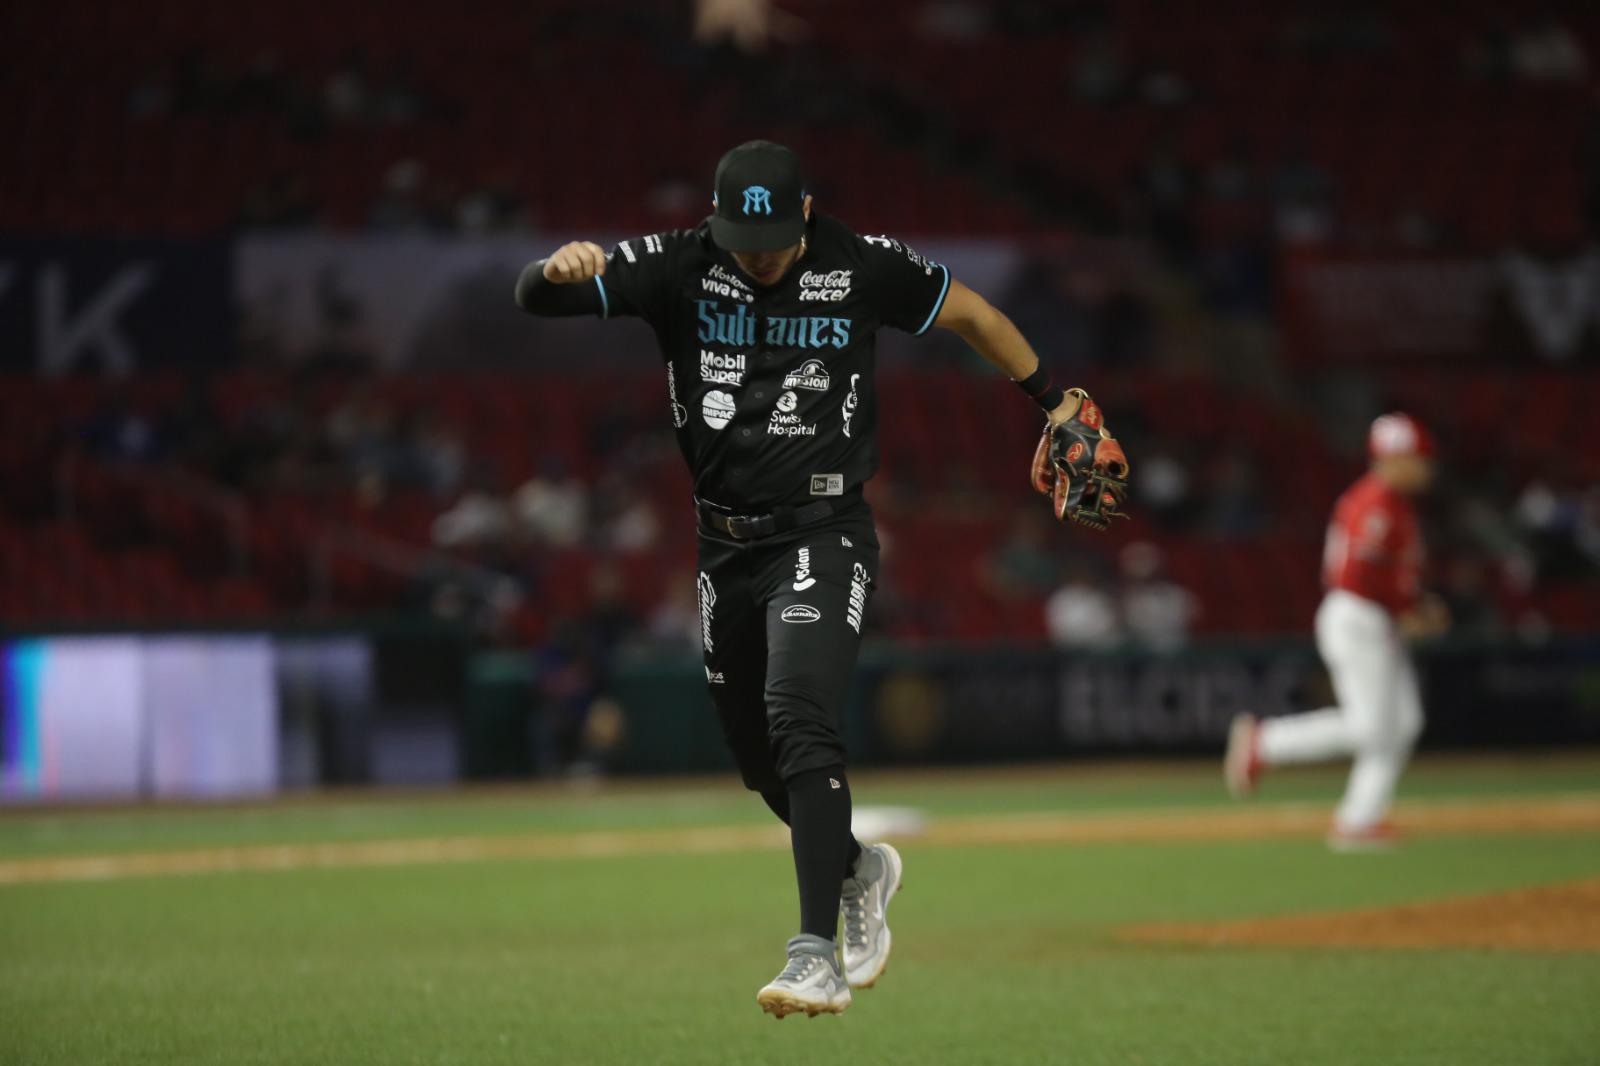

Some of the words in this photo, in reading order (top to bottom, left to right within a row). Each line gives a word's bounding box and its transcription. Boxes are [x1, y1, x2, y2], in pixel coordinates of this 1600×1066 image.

[702, 278, 731, 297] viva
[799, 287, 852, 301] telcel
[701, 349, 746, 370] Mobil
[700, 364, 745, 384] Super
[767, 422, 817, 438] Hospital
